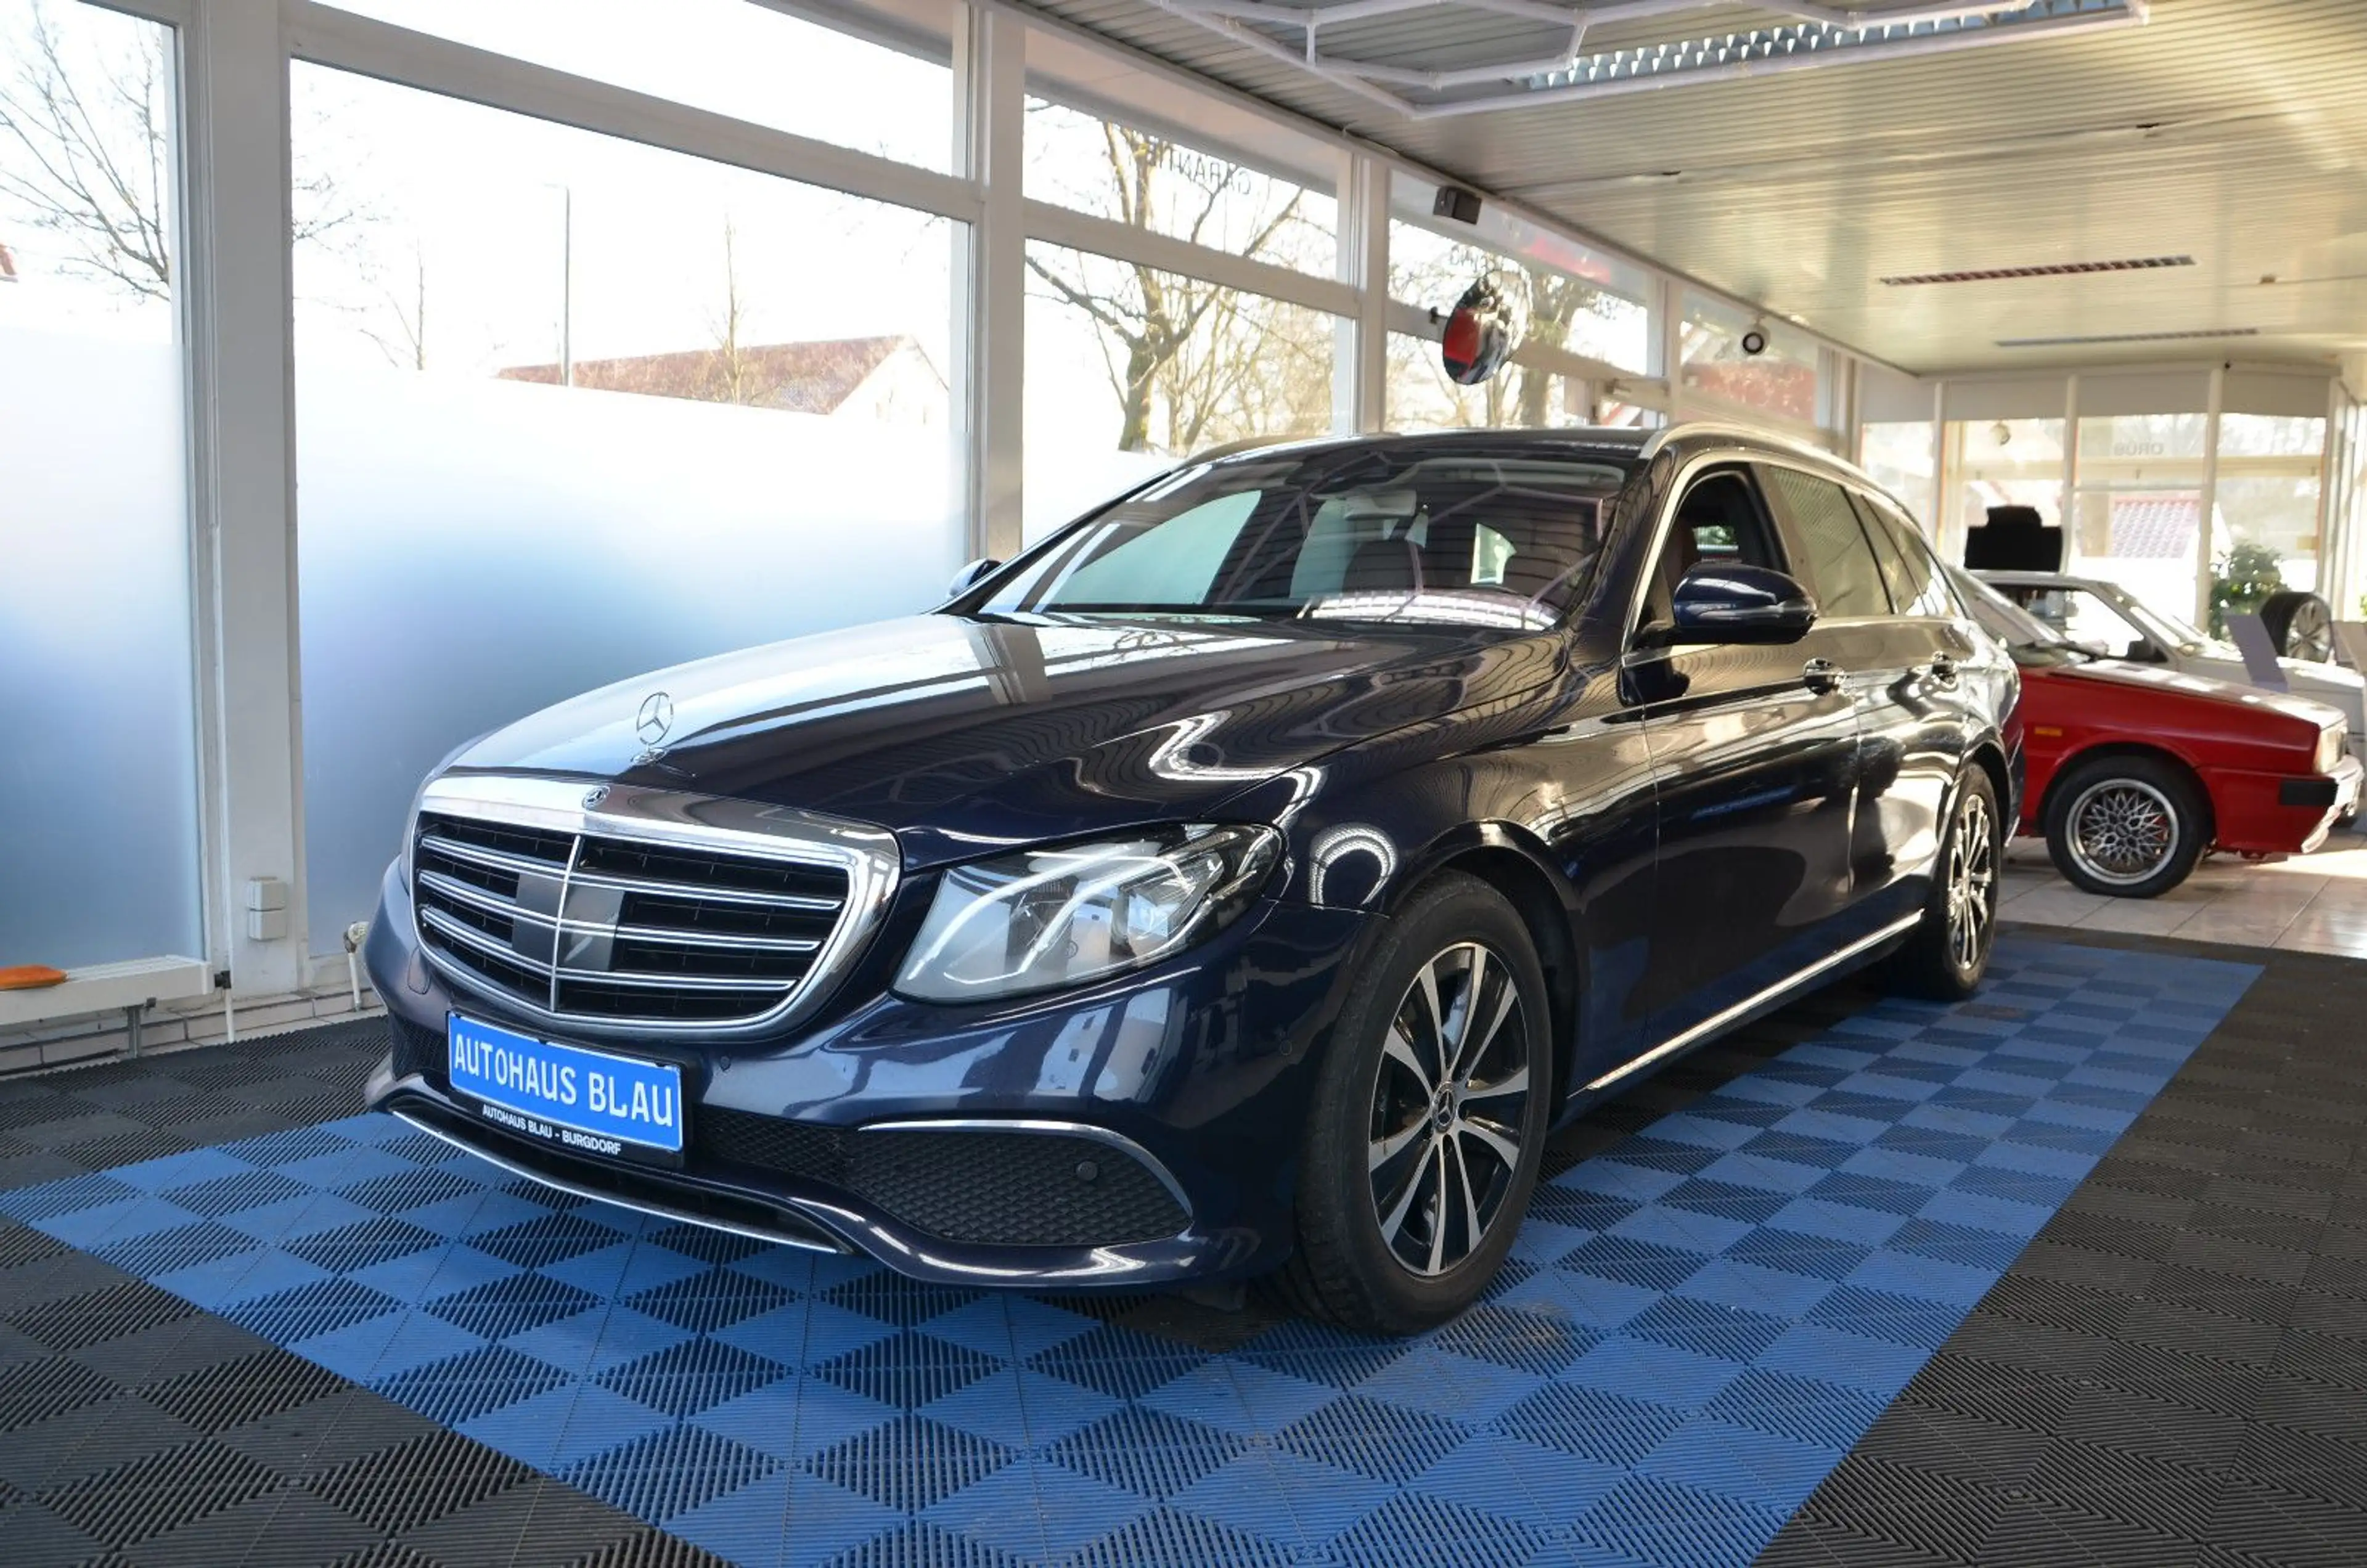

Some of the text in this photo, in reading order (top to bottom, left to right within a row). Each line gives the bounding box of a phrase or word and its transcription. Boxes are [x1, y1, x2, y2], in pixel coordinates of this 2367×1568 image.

[454, 1033, 673, 1128] AUTOHAUS BLAU
[482, 1103, 527, 1130] AUTOHAUS
[528, 1119, 553, 1138] BLAU
[562, 1129, 622, 1155] BURGDORF
